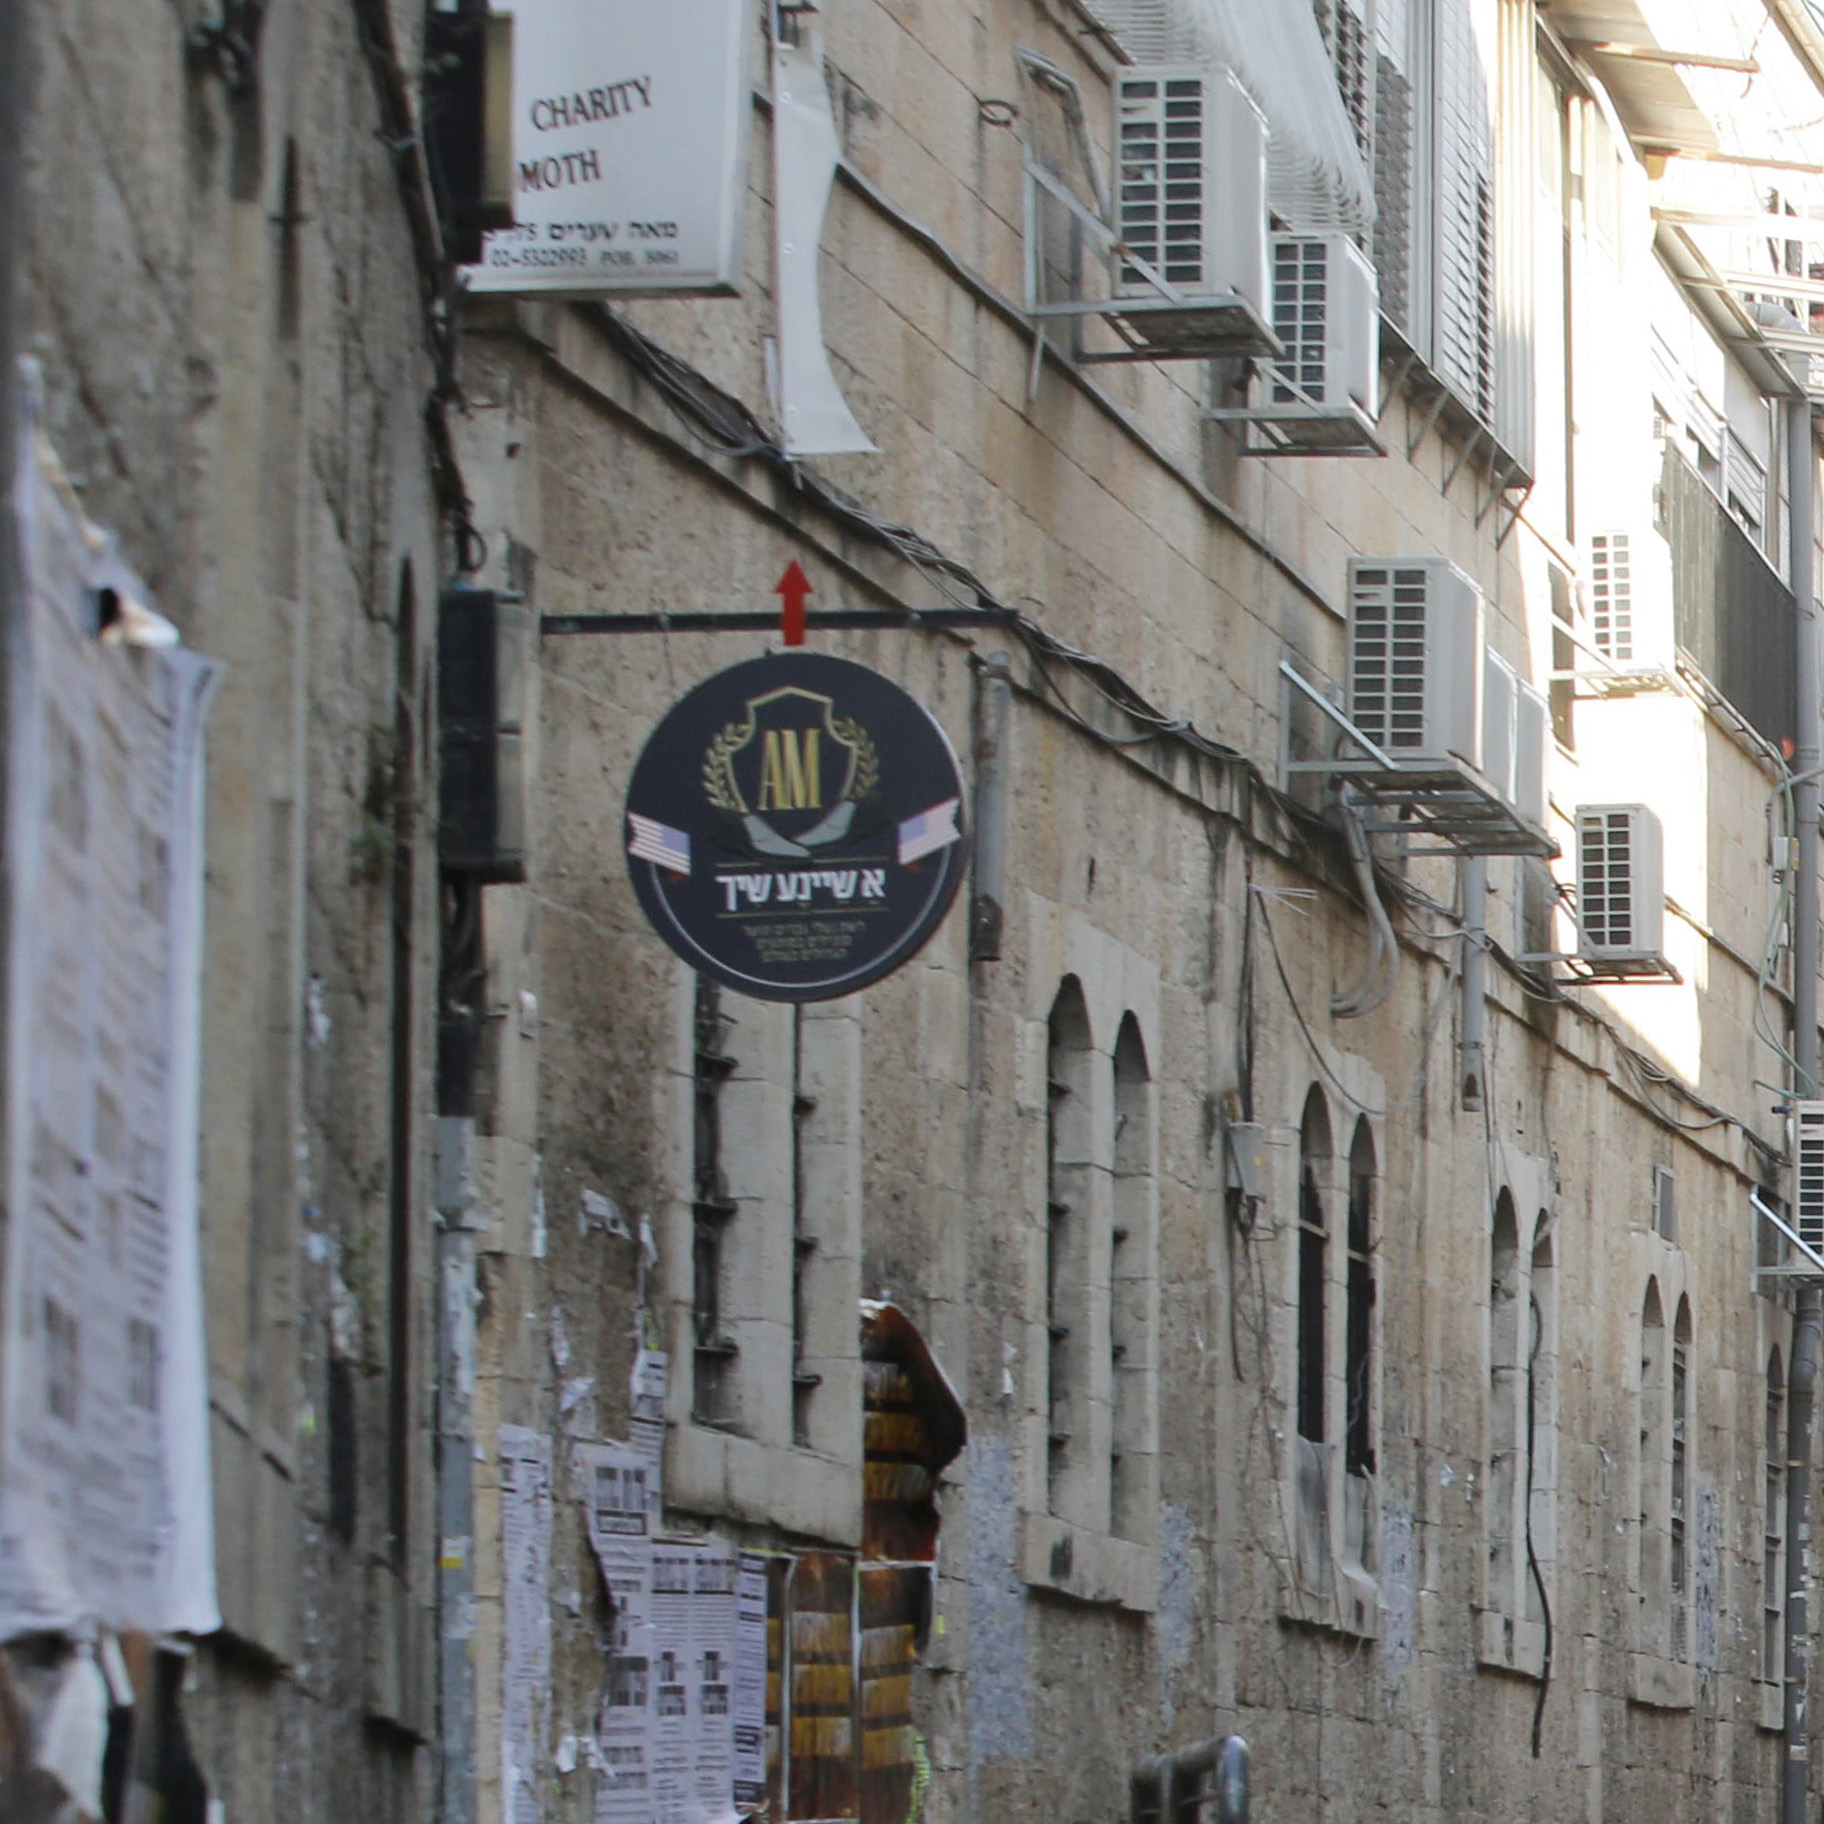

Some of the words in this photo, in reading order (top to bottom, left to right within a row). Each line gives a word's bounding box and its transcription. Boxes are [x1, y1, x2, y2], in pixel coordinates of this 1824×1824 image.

[531, 75, 652, 131] CHARITY
[548, 222, 618, 241] שערים
[629, 221, 678, 239] מאה
[758, 728, 821, 810] AM
